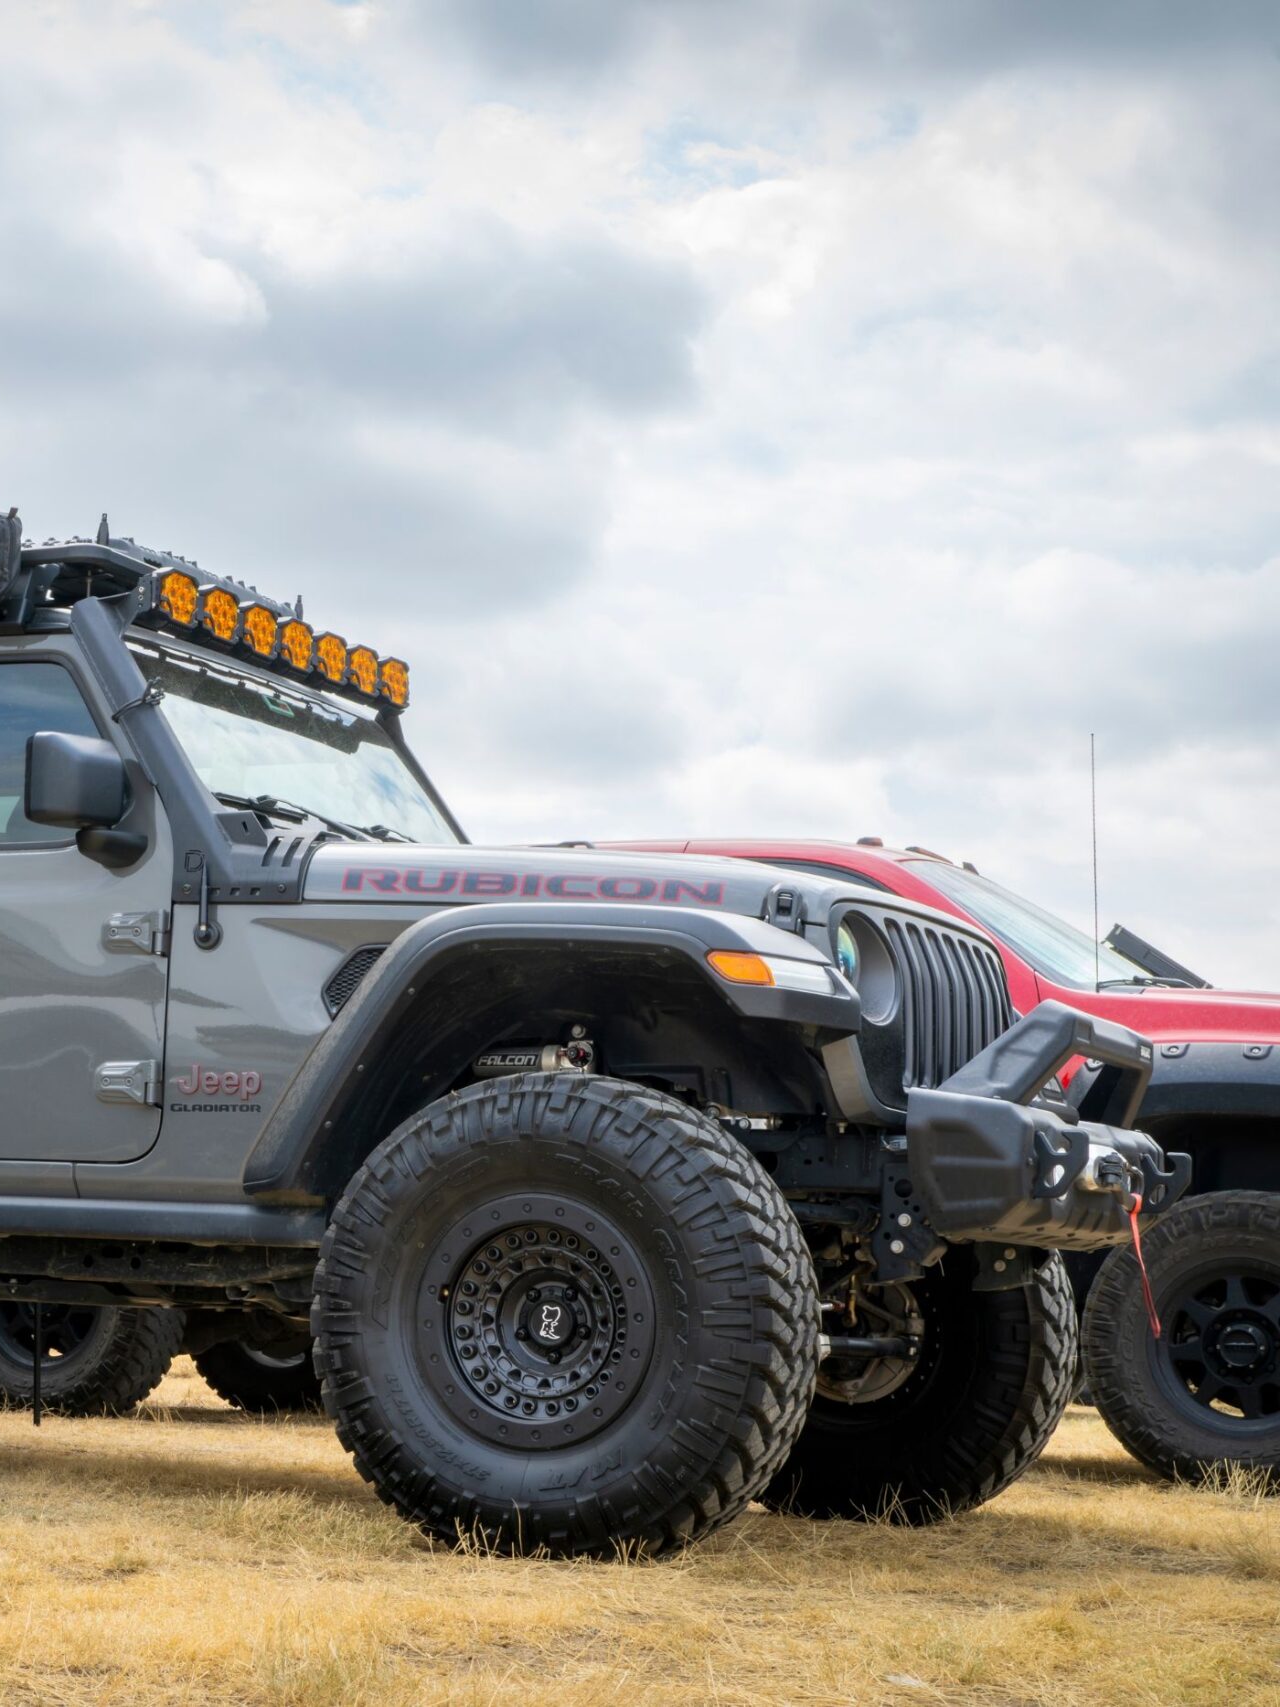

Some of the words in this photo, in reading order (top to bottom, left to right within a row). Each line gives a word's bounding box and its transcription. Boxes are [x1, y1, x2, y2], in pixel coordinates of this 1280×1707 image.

[340, 867, 726, 905] RUBICON
[477, 1054, 536, 1066] FALCON
[176, 1063, 263, 1101] Jeep
[170, 1103, 262, 1113] GLADIATOR
